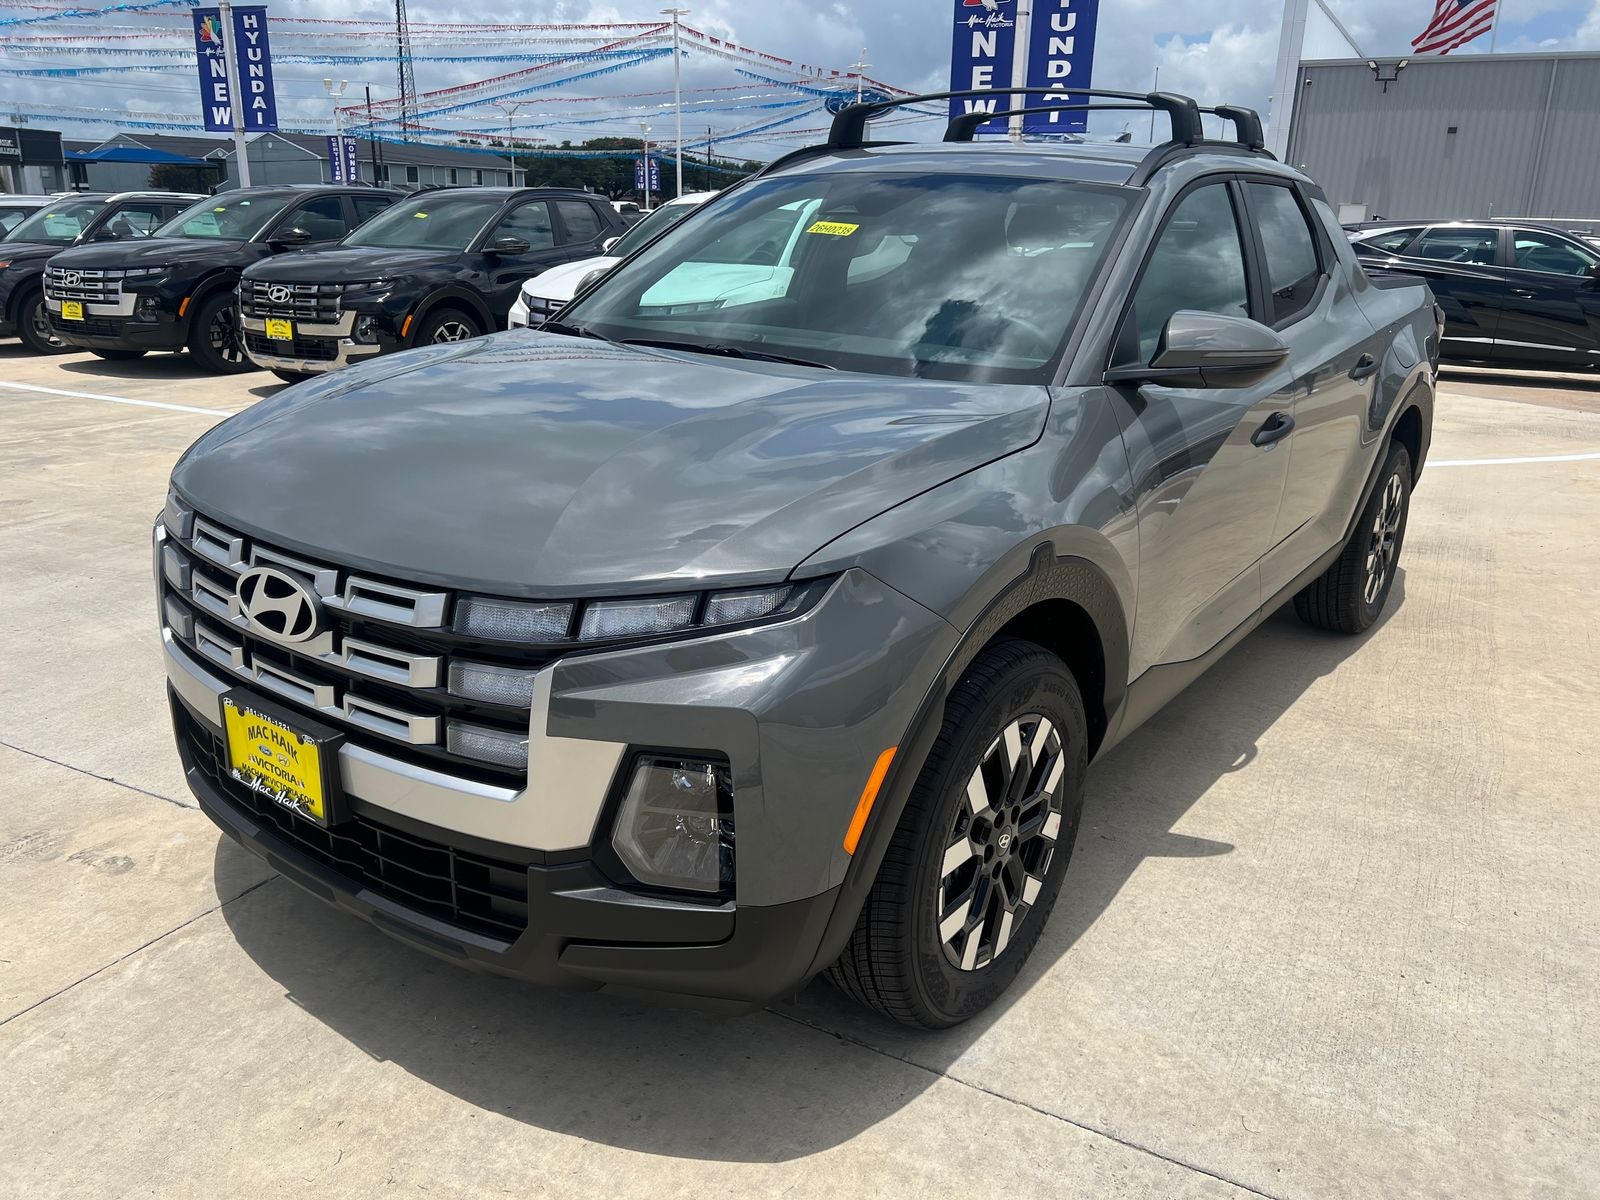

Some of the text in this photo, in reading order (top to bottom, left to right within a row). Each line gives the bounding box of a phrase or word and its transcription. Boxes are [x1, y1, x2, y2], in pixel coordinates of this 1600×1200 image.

[243, 15, 267, 125] HYUNDAI
[963, 30, 998, 125] NEW
[210, 59, 231, 125] NEW
[331, 137, 341, 180] CERTIFIED
[348, 146, 356, 180] OWNED
[248, 725, 269, 740] MAC
[270, 729, 299, 764] HAIK
[254, 757, 297, 785] VICTORIA
[248, 776, 306, 813] Mac Haik
